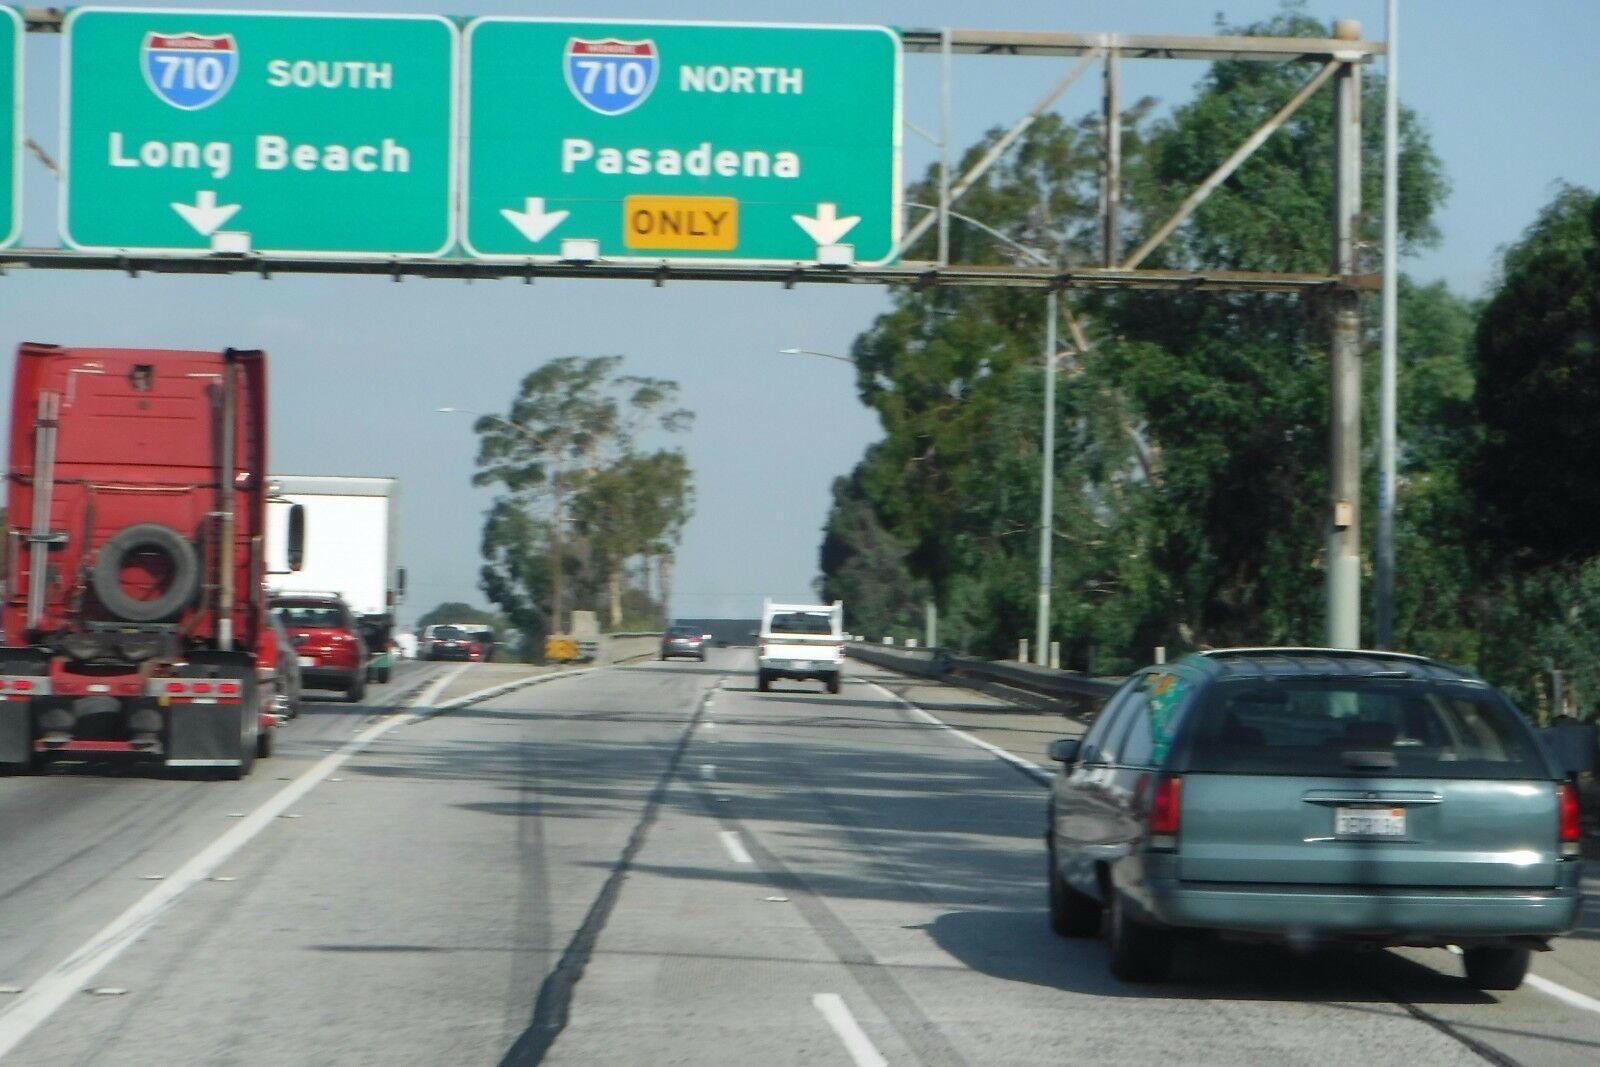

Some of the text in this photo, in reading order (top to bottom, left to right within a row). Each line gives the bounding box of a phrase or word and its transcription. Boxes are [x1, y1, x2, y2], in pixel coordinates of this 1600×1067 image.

[155, 56, 225, 90] 710
[267, 59, 392, 89] SOUTH
[577, 61, 647, 95] 710
[679, 65, 803, 94] NORTH
[109, 131, 410, 179] Long Beach
[562, 138, 800, 178] Pasadena
[631, 208, 729, 237] ONLY
